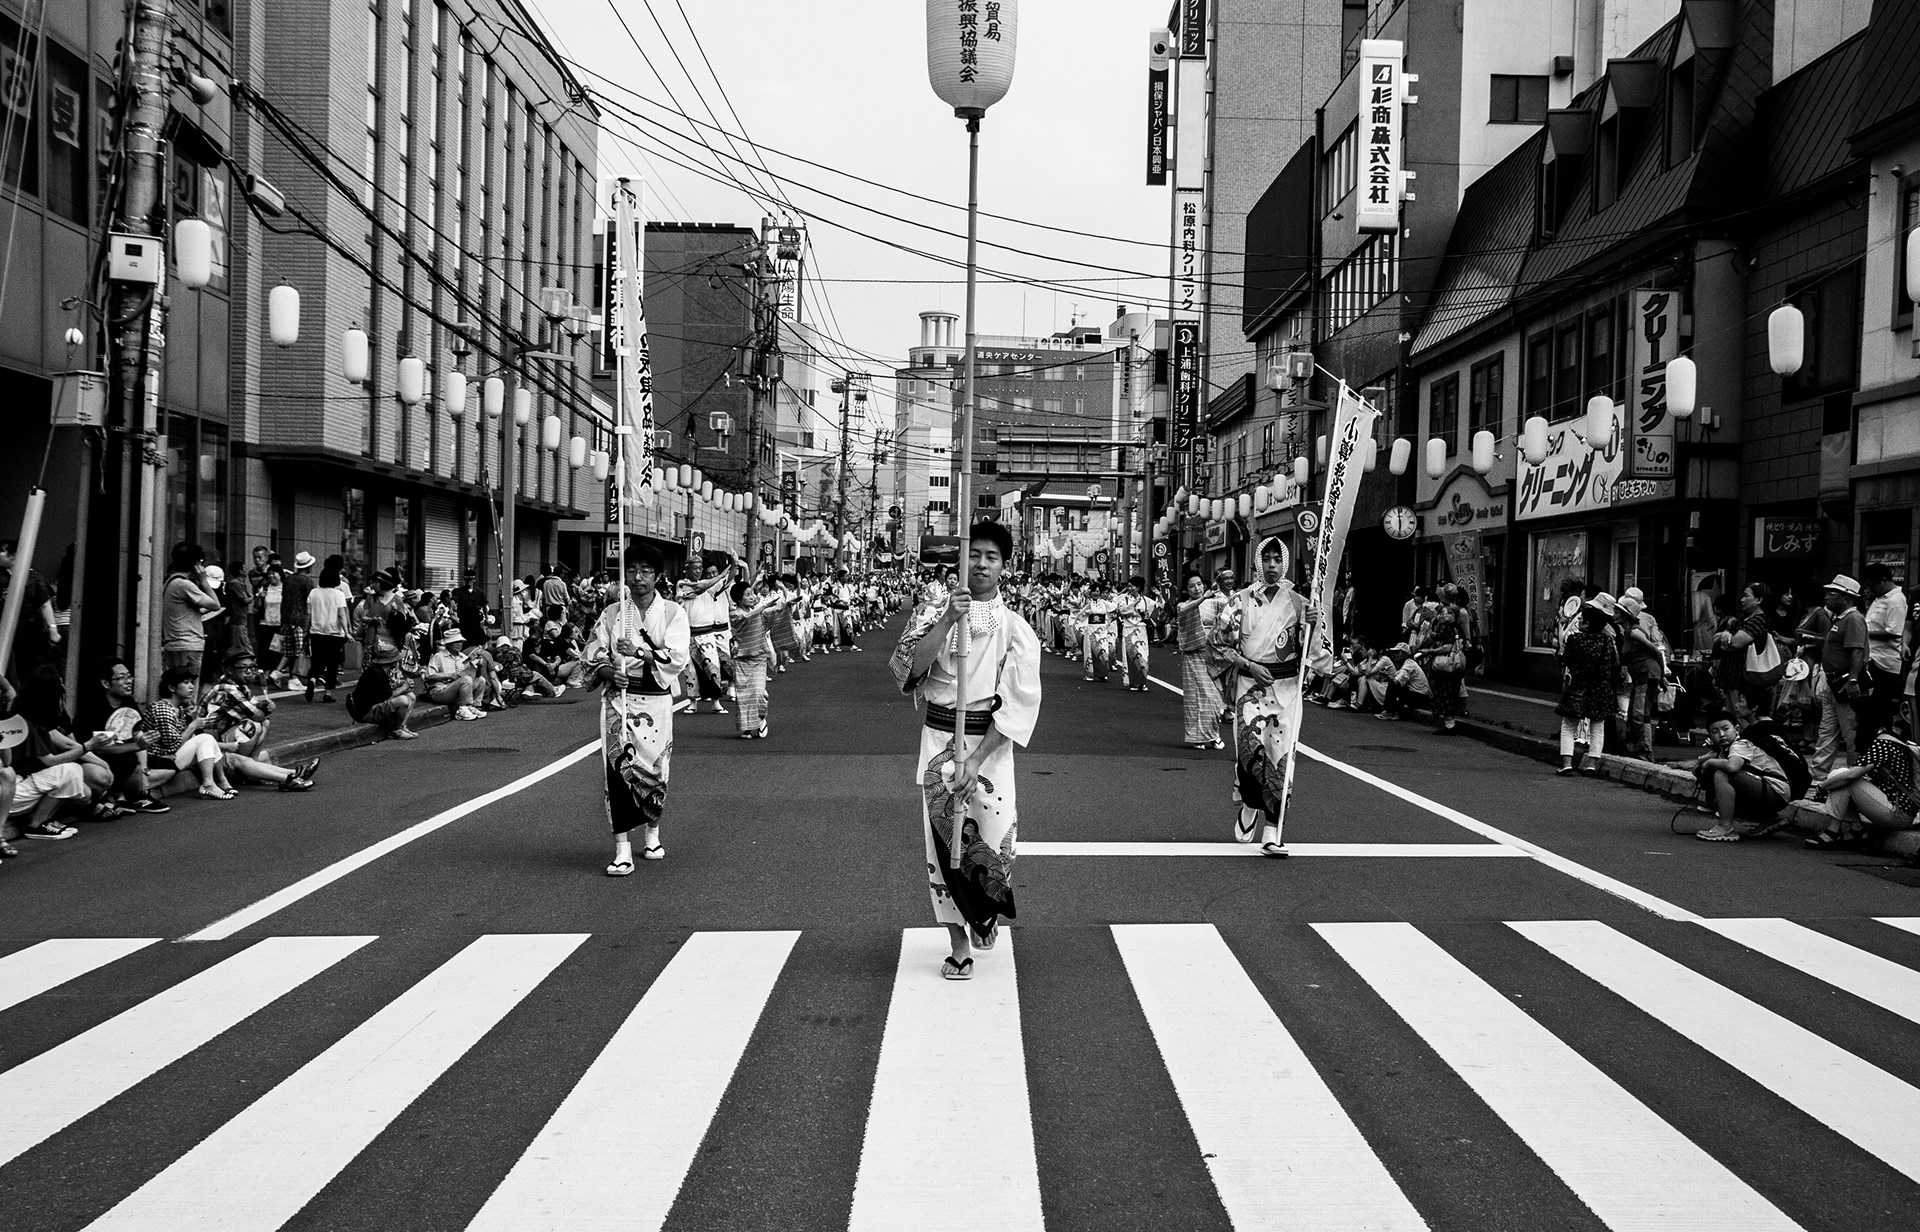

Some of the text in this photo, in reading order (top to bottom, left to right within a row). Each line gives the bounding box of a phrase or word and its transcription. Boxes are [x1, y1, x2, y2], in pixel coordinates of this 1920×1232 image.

[984, 1, 1002, 42] 貿易
[1152, 81, 1164, 174] 損保ジャパン日本興亜
[1369, 86, 1392, 204] 杉商株式会社
[1181, 202, 1196, 310] 松原内科クリニック
[977, 351, 1042, 361] 道央ケアセンター
[1179, 346, 1192, 448] 上浦歯科クリニック
[1639, 293, 1670, 433] クリーニング
[1519, 450, 1595, 516] クリーニング
[1768, 533, 1819, 553] しみず
